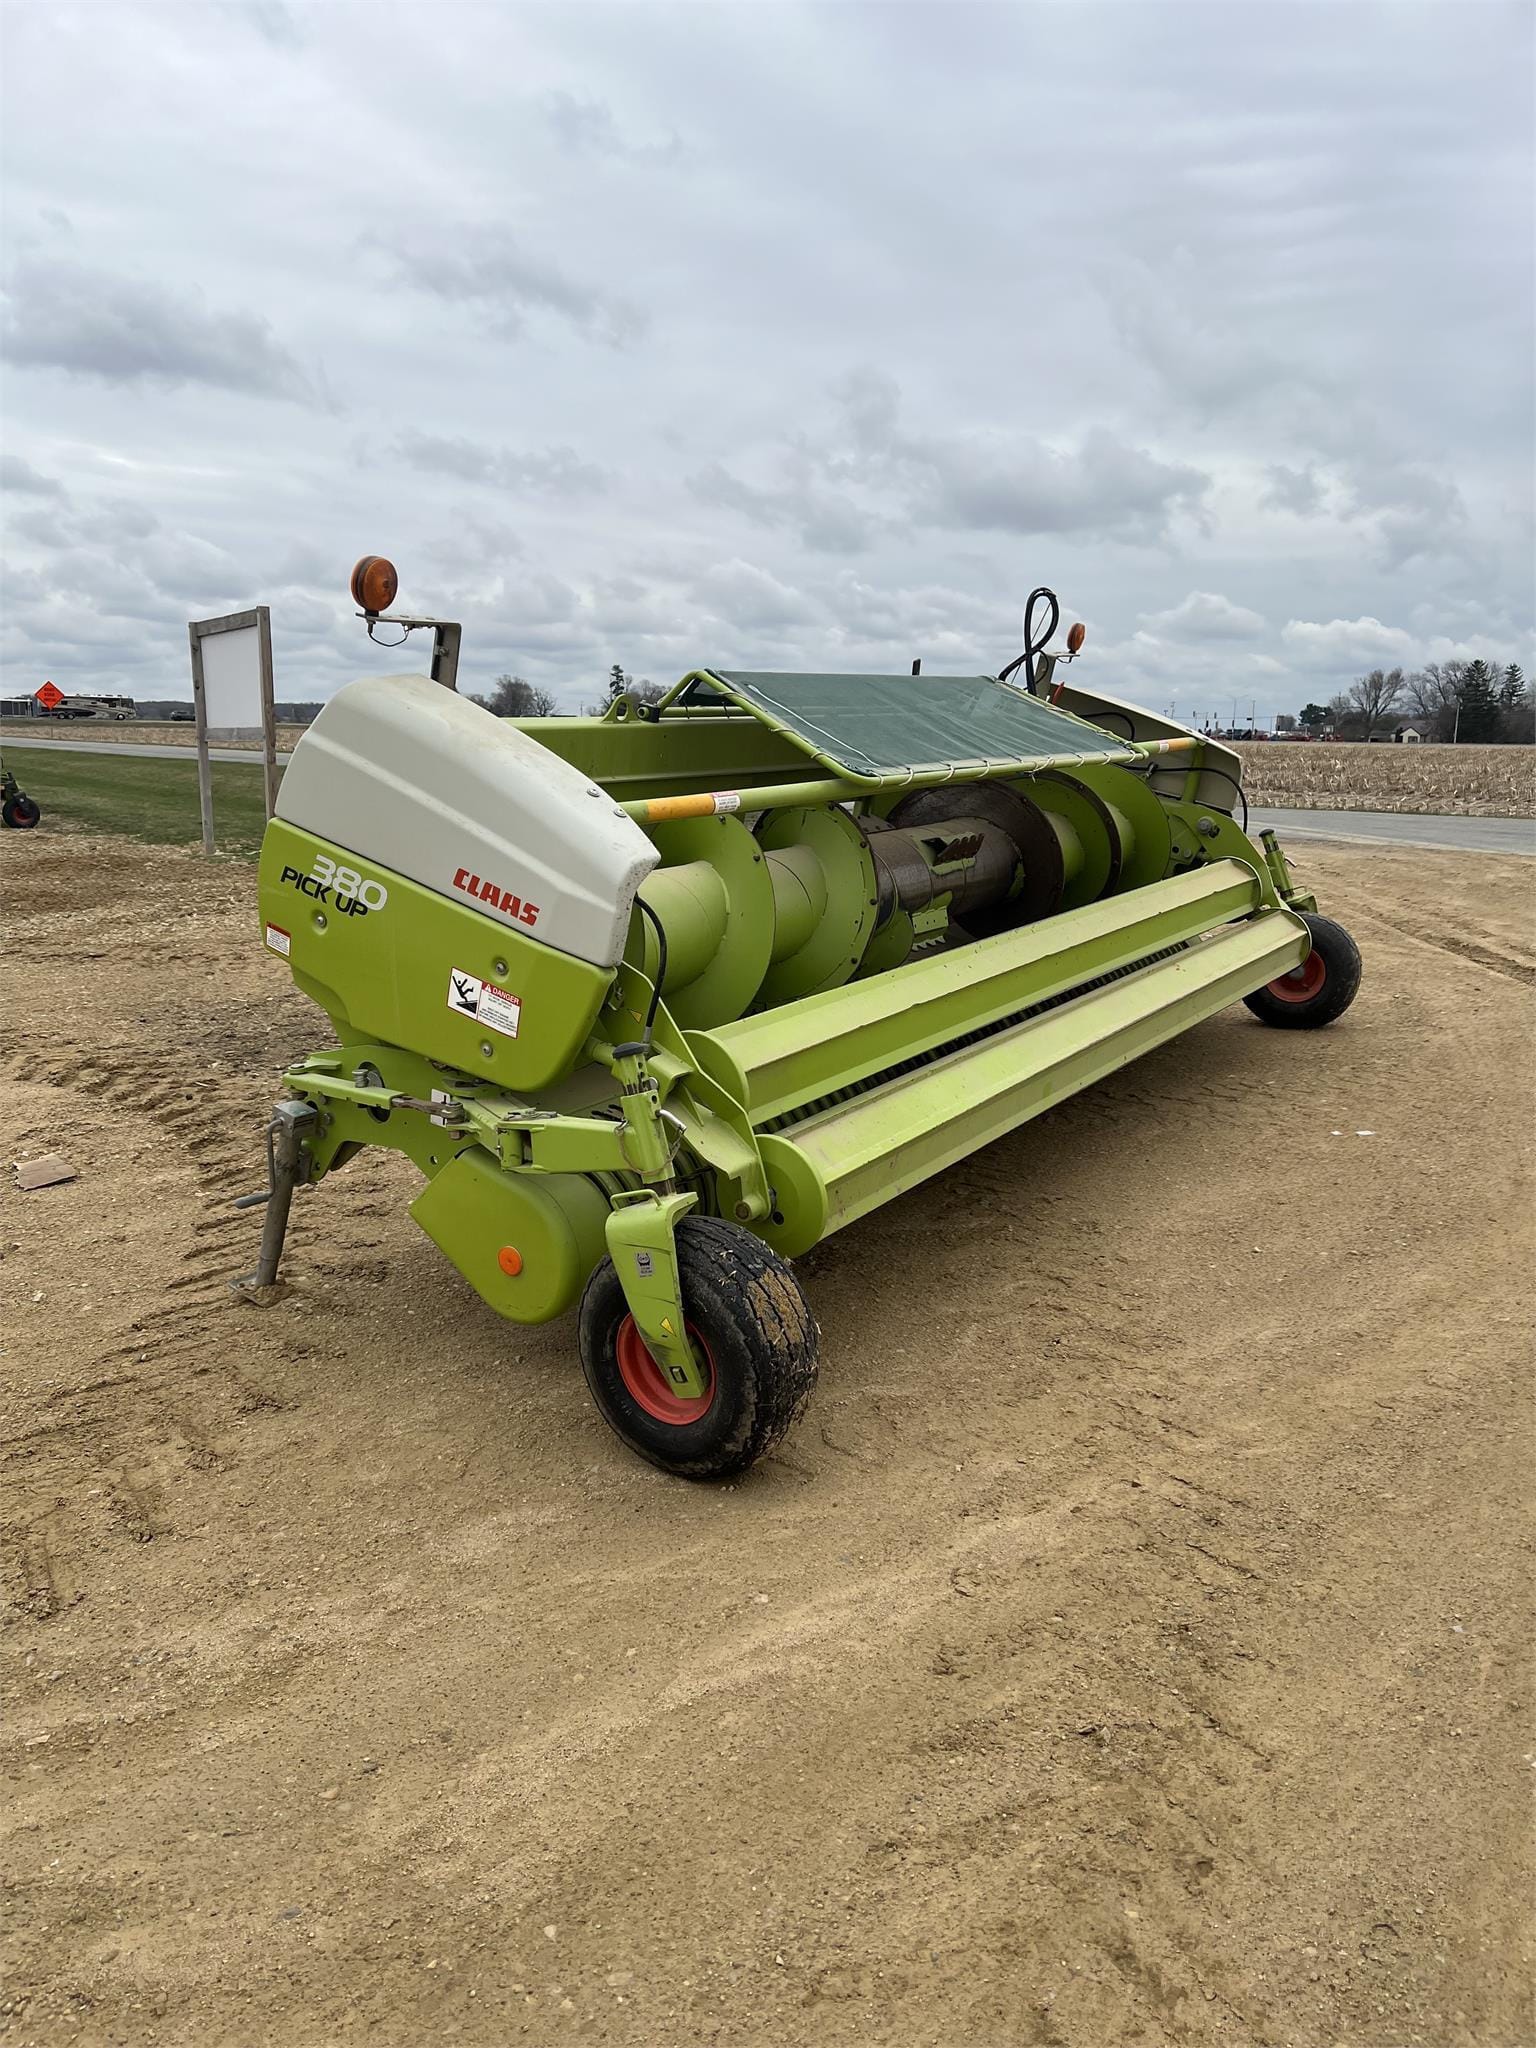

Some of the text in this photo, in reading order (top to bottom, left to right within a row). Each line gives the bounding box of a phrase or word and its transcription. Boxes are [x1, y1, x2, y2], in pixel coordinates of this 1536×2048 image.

[280, 866, 369, 917] PICK UP
[309, 854, 388, 911] 380
[453, 868, 540, 926] CLAAS
[492, 987, 520, 1005] DANGER
